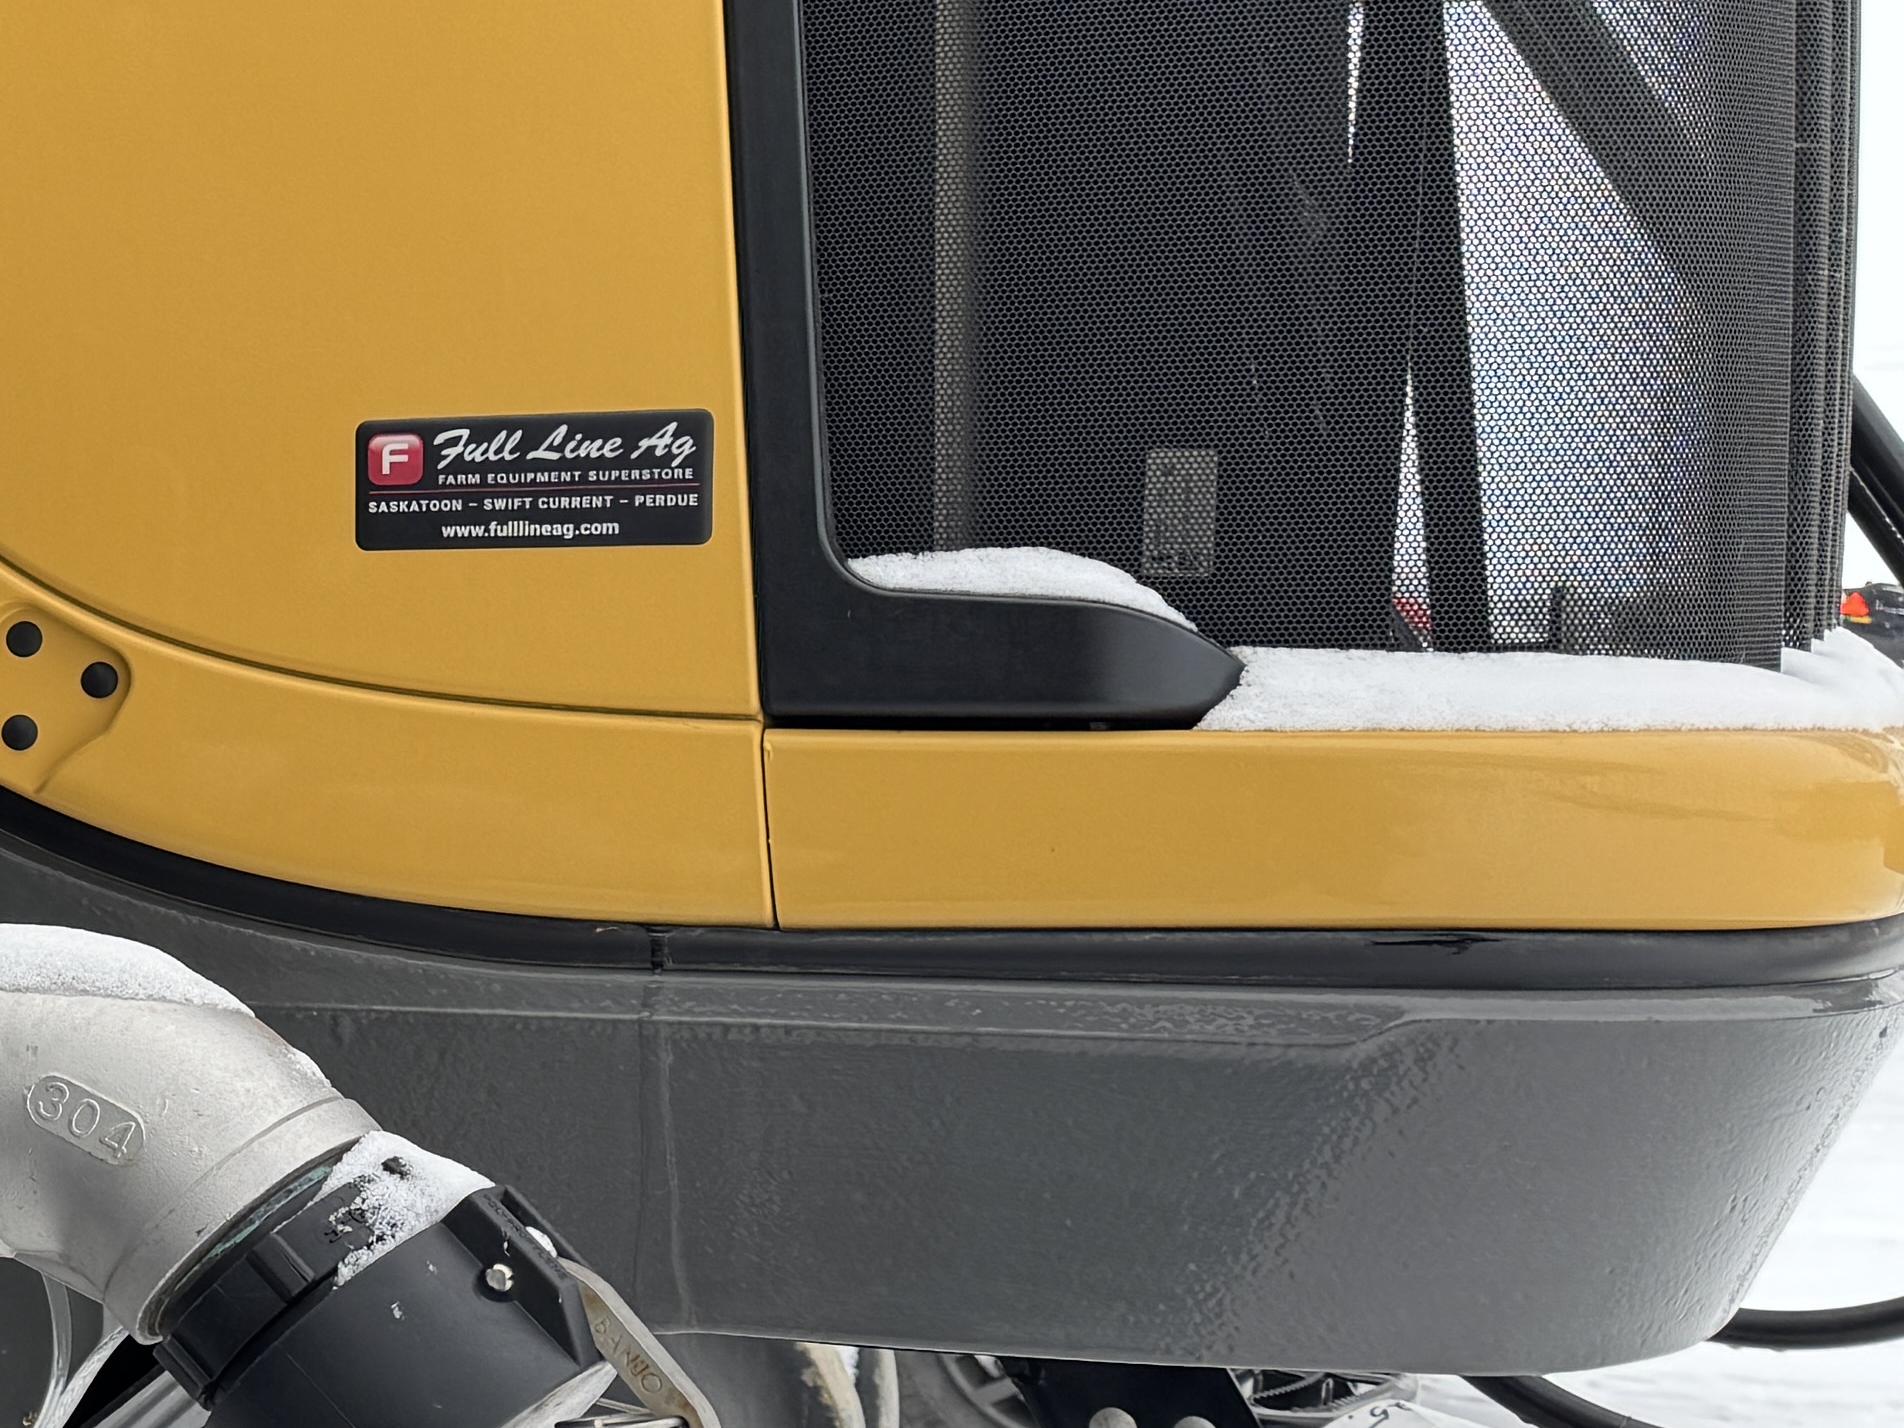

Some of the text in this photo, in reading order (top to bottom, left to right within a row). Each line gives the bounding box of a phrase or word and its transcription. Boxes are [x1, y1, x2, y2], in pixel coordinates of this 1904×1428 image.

[433, 421, 697, 470] Full Line Ag
[438, 468, 694, 486] FARM EQUIPMENT SUPERSTORE
[368, 499, 463, 513] SASKATOON
[483, 497, 533, 511] SWIFT
[538, 495, 614, 509] CURRENT
[635, 493, 699, 507] PERDUE
[441, 520, 620, 539] www.fulllineag.com
[35, 1080, 137, 1159] 304
[593, 1316, 663, 1395] BANJO
